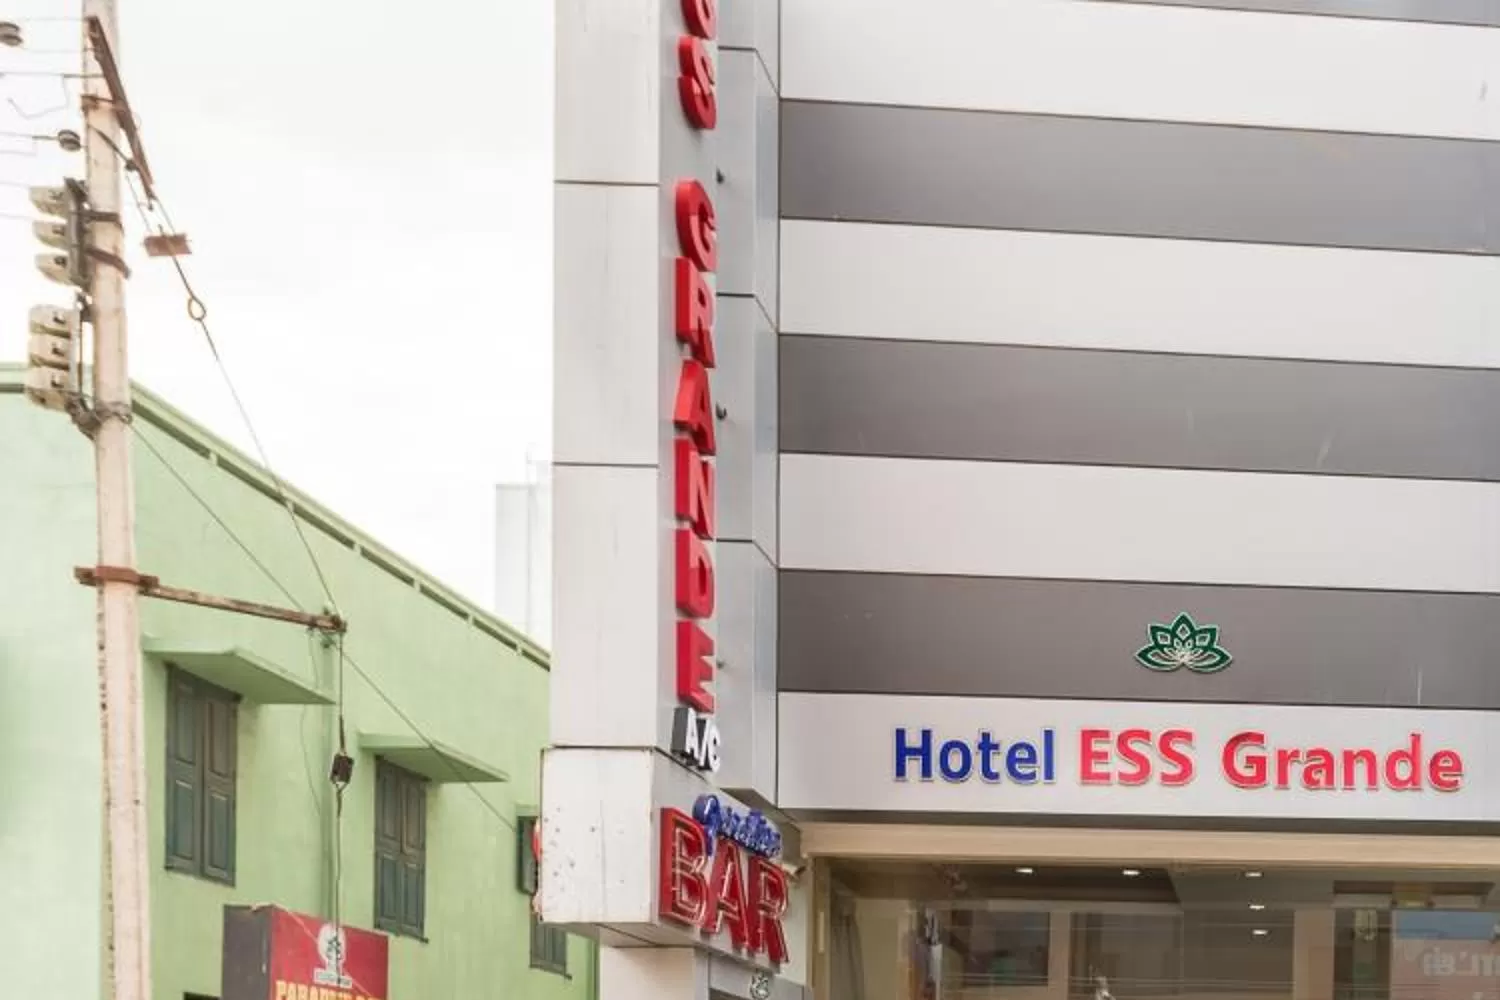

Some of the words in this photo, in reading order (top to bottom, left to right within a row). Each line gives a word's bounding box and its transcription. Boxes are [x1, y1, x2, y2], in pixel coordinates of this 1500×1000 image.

[674, 180, 717, 712] GRANDE
[893, 728, 1055, 786] Hotel
[1078, 728, 1194, 787] ESS
[1221, 733, 1465, 792] Grande
[659, 807, 789, 966] BAR
